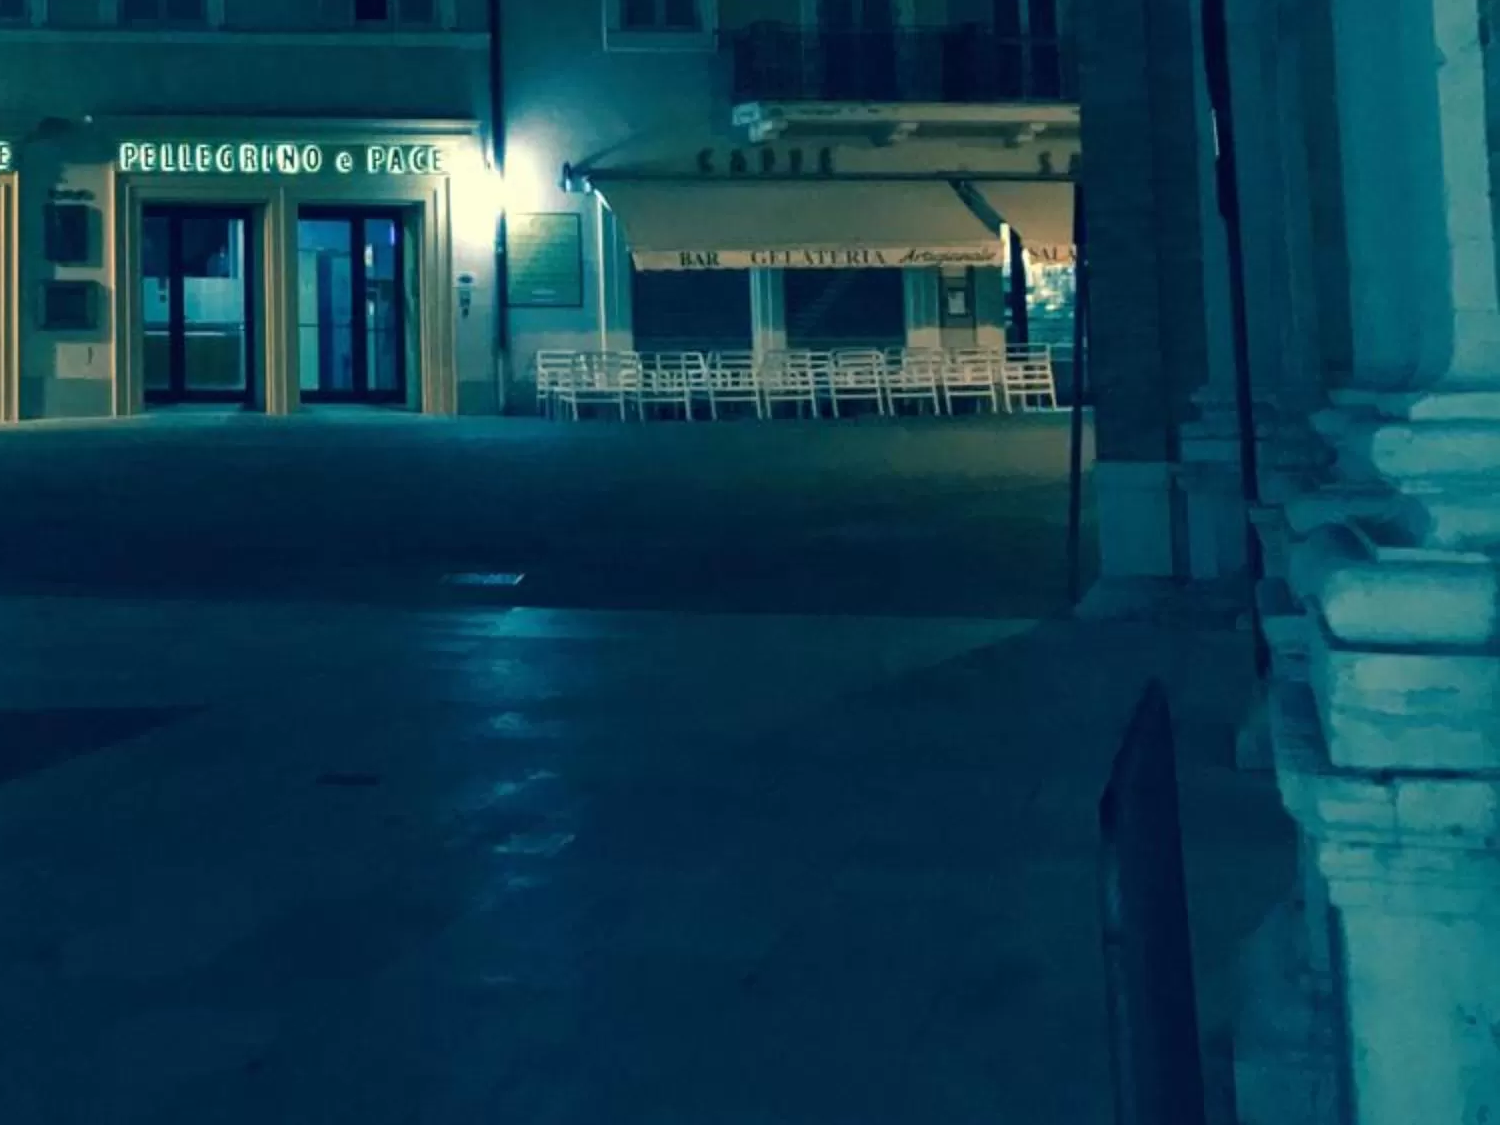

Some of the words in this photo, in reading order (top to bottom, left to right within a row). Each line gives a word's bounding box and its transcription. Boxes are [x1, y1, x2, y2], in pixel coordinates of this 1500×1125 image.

[119, 141, 324, 173] PELLEGRINO
[335, 151, 354, 173] e
[366, 145, 444, 173] PACE
[679, 251, 720, 266] BAR
[751, 250, 885, 265] GELATERIA
